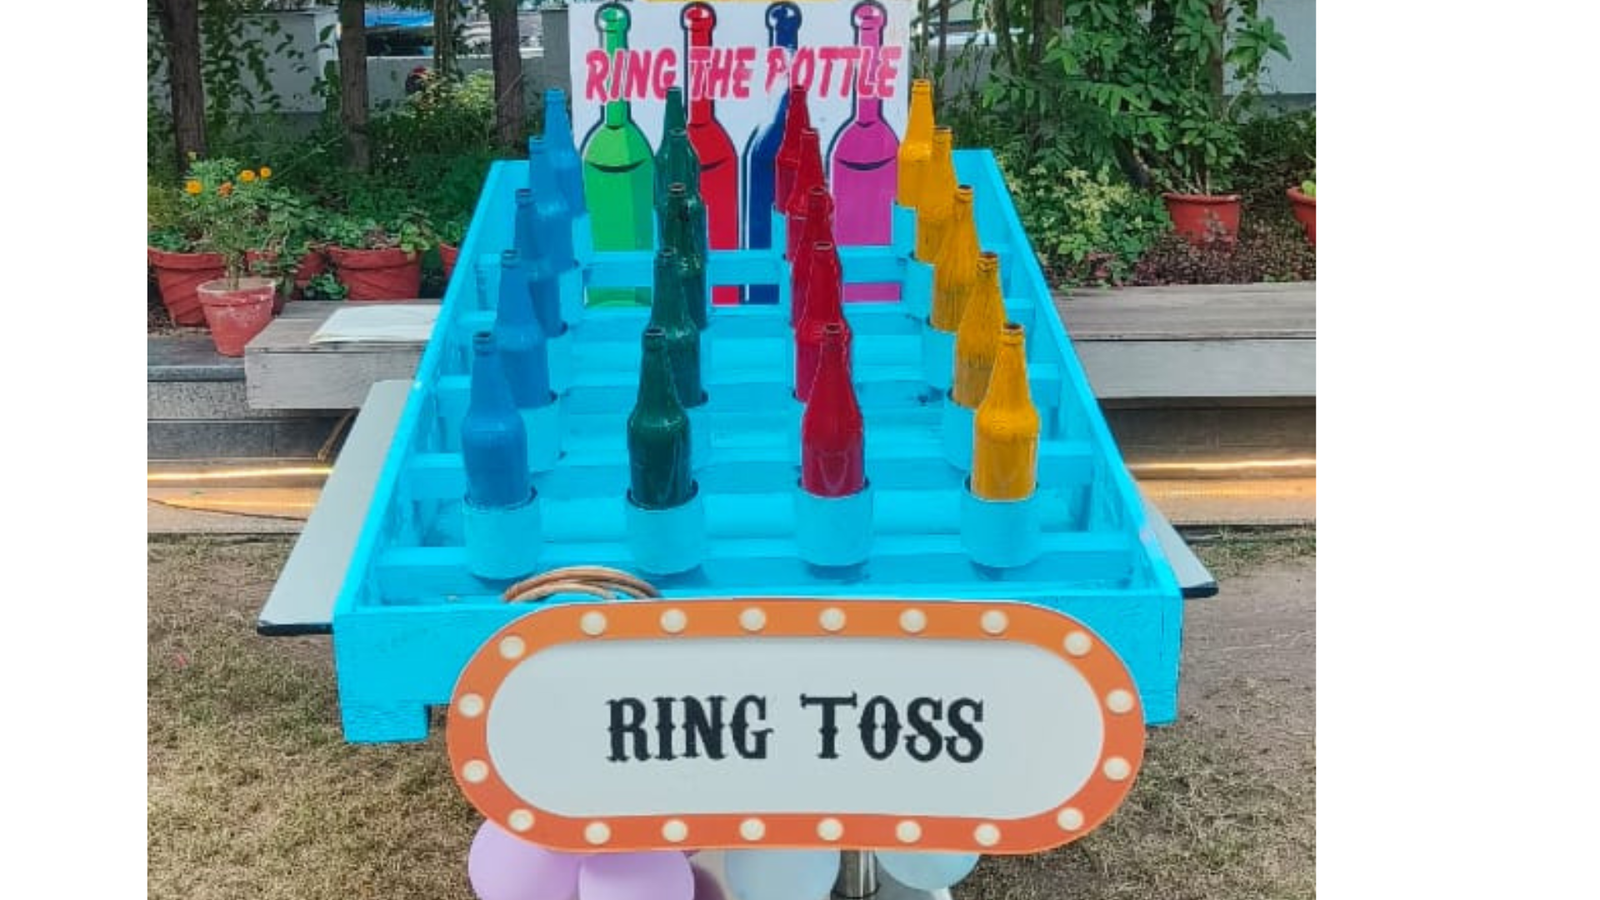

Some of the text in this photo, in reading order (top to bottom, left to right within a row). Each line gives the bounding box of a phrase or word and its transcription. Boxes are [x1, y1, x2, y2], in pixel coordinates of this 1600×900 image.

[585, 48, 677, 100] RING
[690, 47, 755, 99] THE
[606, 692, 984, 763] RING TOSS
